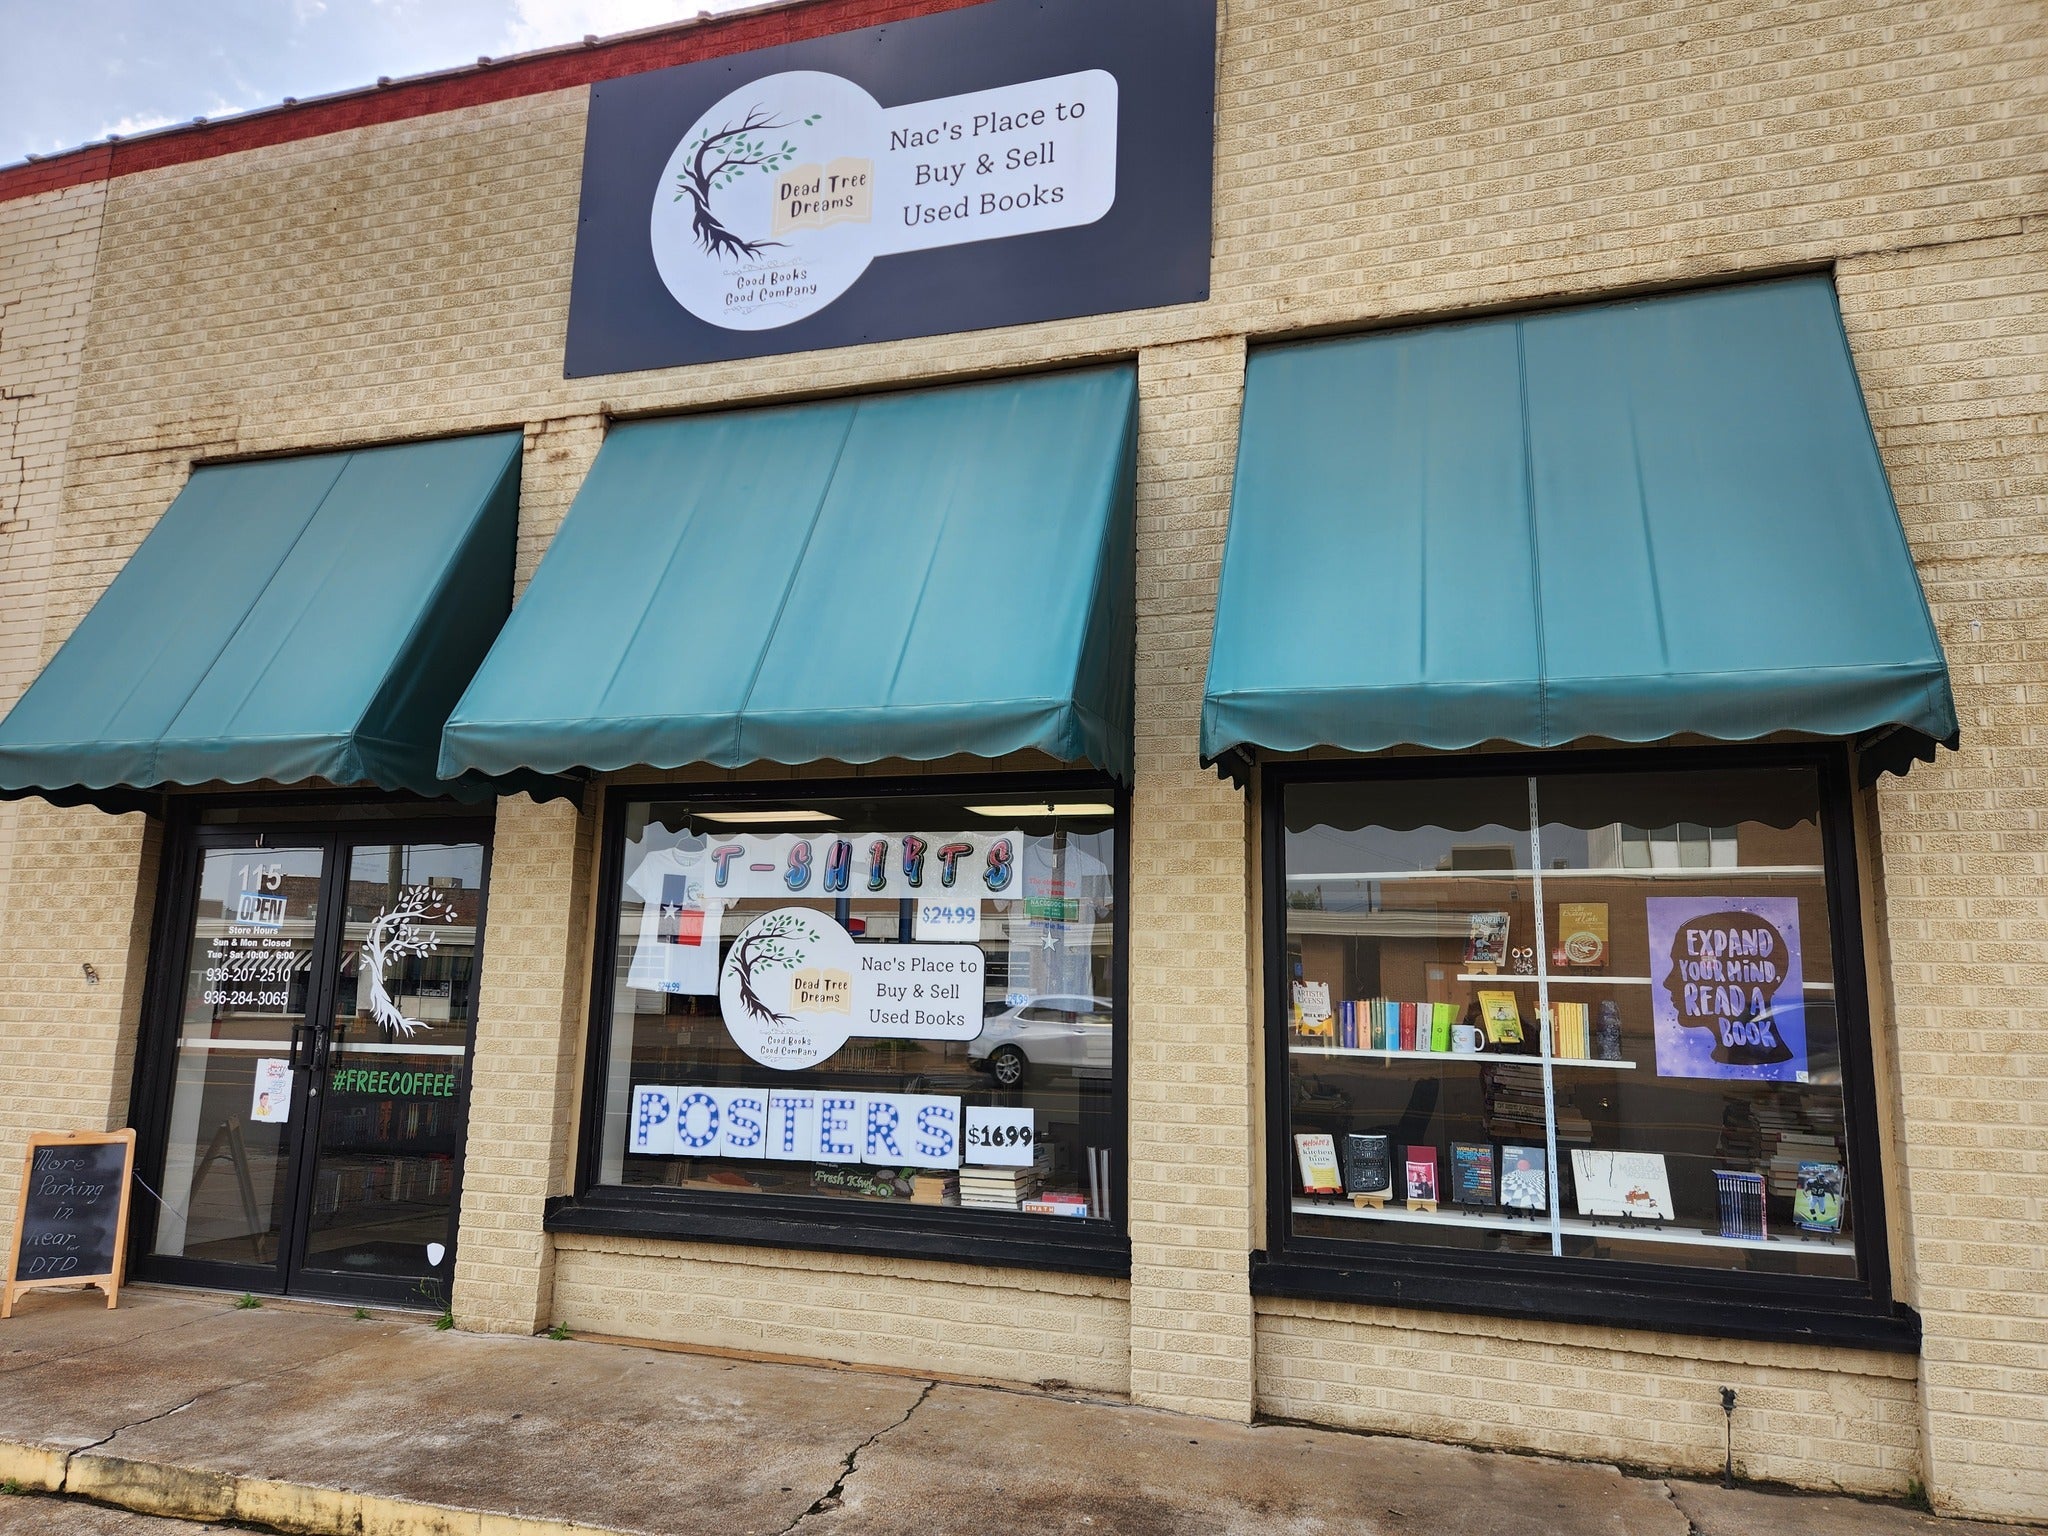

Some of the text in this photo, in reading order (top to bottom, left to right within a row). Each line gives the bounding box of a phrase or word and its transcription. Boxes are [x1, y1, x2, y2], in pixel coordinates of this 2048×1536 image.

[890, 101, 1086, 150] Nac's Place to
[914, 141, 1055, 186] Buy & Sell
[780, 173, 866, 200] Dead Tree
[791, 195, 854, 218] Dreams
[903, 184, 1064, 226] Used Books
[736, 269, 807, 289] Good Books
[726, 290, 754, 306] Good
[711, 835, 1014, 892] T-SHIRTS
[239, 863, 282, 891] 115
[240, 896, 283, 921] OPEN
[922, 906, 976, 924] $24.99
[228, 926, 278, 935] Store Hours
[213, 939, 292, 948] Sun & Mon Closed
[1686, 928, 1774, 957] EXPAND
[207, 951, 223, 959] Tue
[229, 951, 244, 959] Sat
[247, 951, 269, 959] 10:00
[276, 951, 295, 960] 6:00
[861, 957, 977, 973] Nac's Place to
[206, 968, 291, 982] 936-207-2510
[1679, 960, 1726, 982] YOUR
[794, 978, 848, 991] Dead Tree
[877, 983, 960, 1001] Buy & Sell
[203, 991, 289, 1005] 936-284-3065
[801, 991, 840, 1003] Dreams
[1684, 983, 1767, 1017] READ A
[869, 1009, 965, 1026] Used Books
[767, 1036, 811, 1046] Good Books
[1718, 1017, 1777, 1048] BOOK
[760, 1045, 779, 1055] Good
[332, 1069, 455, 1097] #FREECOFFEE
[637, 1092, 954, 1157] POSTERS
[968, 1124, 1033, 1147] $16.99
[34, 1149, 86, 1172] More
[814, 1170, 845, 1186] Fresh
[37, 1174, 105, 1204] Parking
[53, 1201, 74, 1220] in
[1026, 1205, 1054, 1213] SMATH
[29, 1256, 78, 1274] DTD
